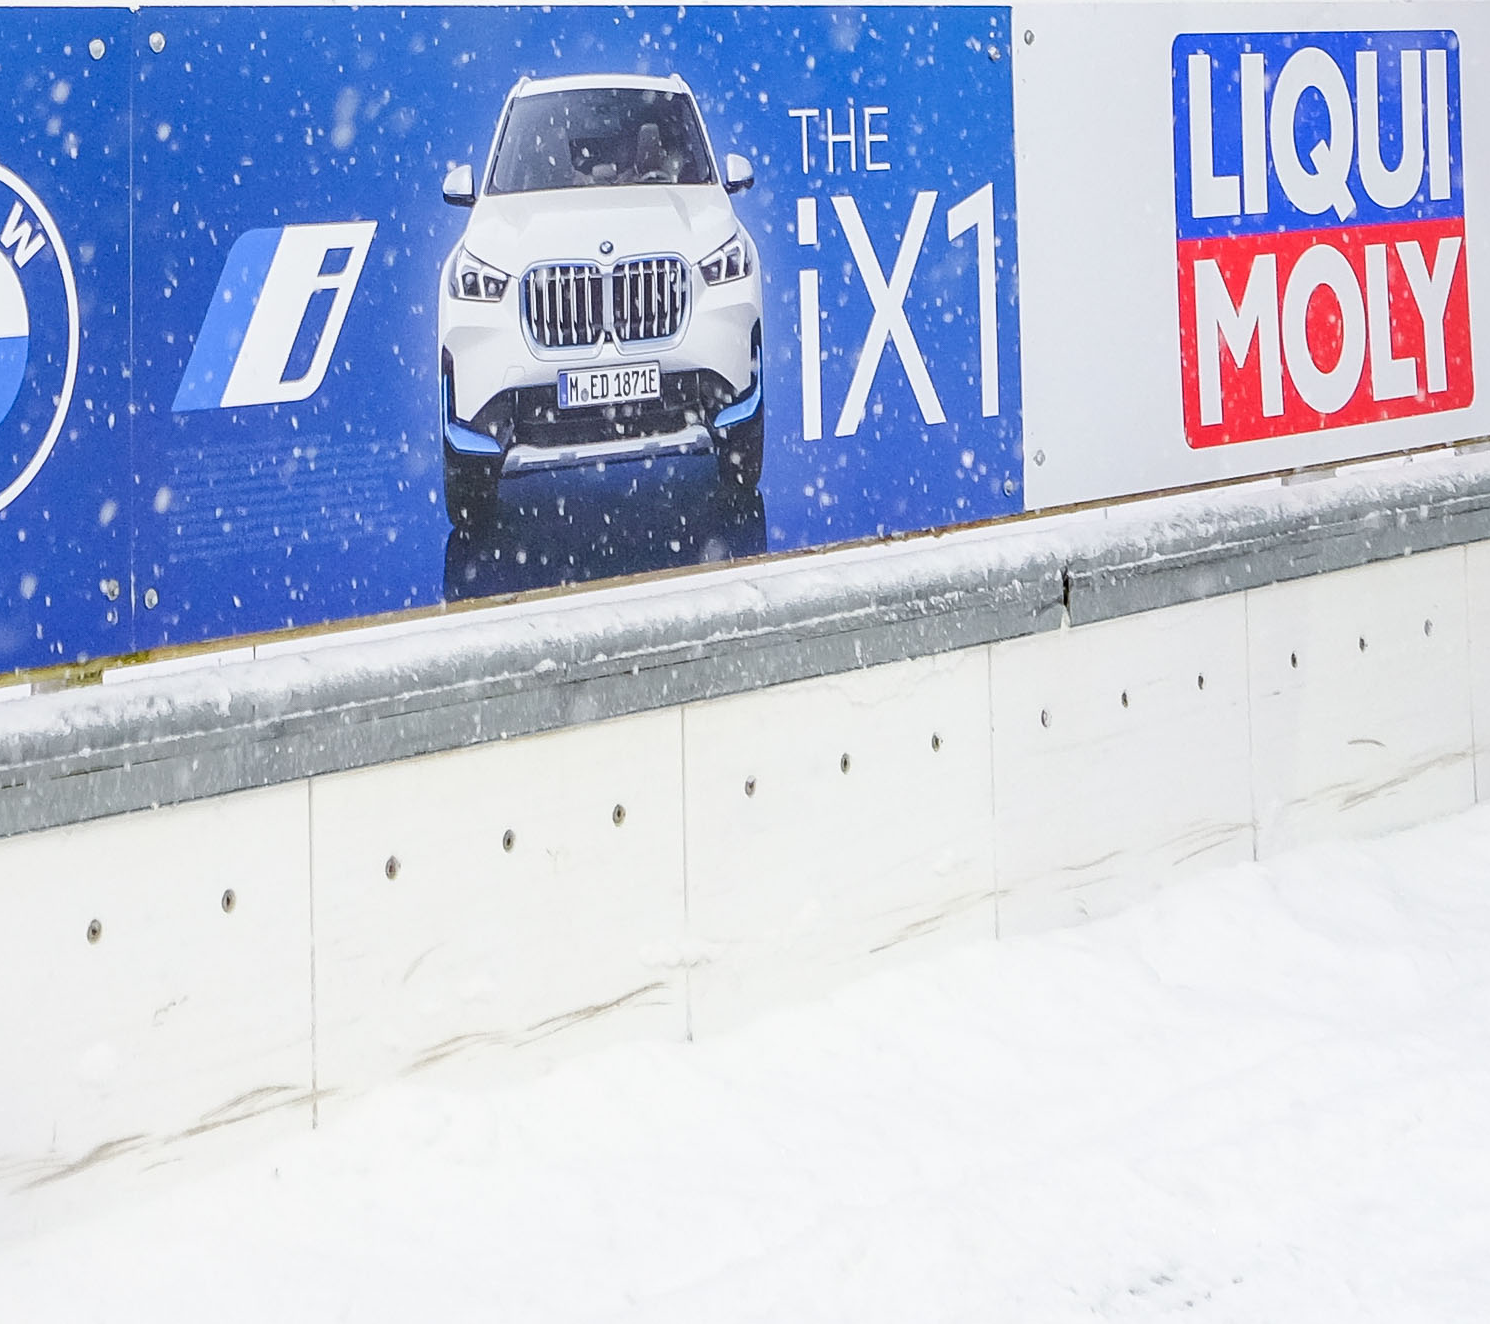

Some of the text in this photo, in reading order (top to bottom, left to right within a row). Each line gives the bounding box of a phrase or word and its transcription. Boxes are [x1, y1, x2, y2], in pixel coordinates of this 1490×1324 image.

[789, 106, 890, 173] THE
[1188, 47, 1452, 223] LIQUI
[591, 374, 609, 399] ED
[614, 369, 657, 397] 1871E
[796, 182, 1000, 441] iX1
[1193, 235, 1462, 427] MOLY
